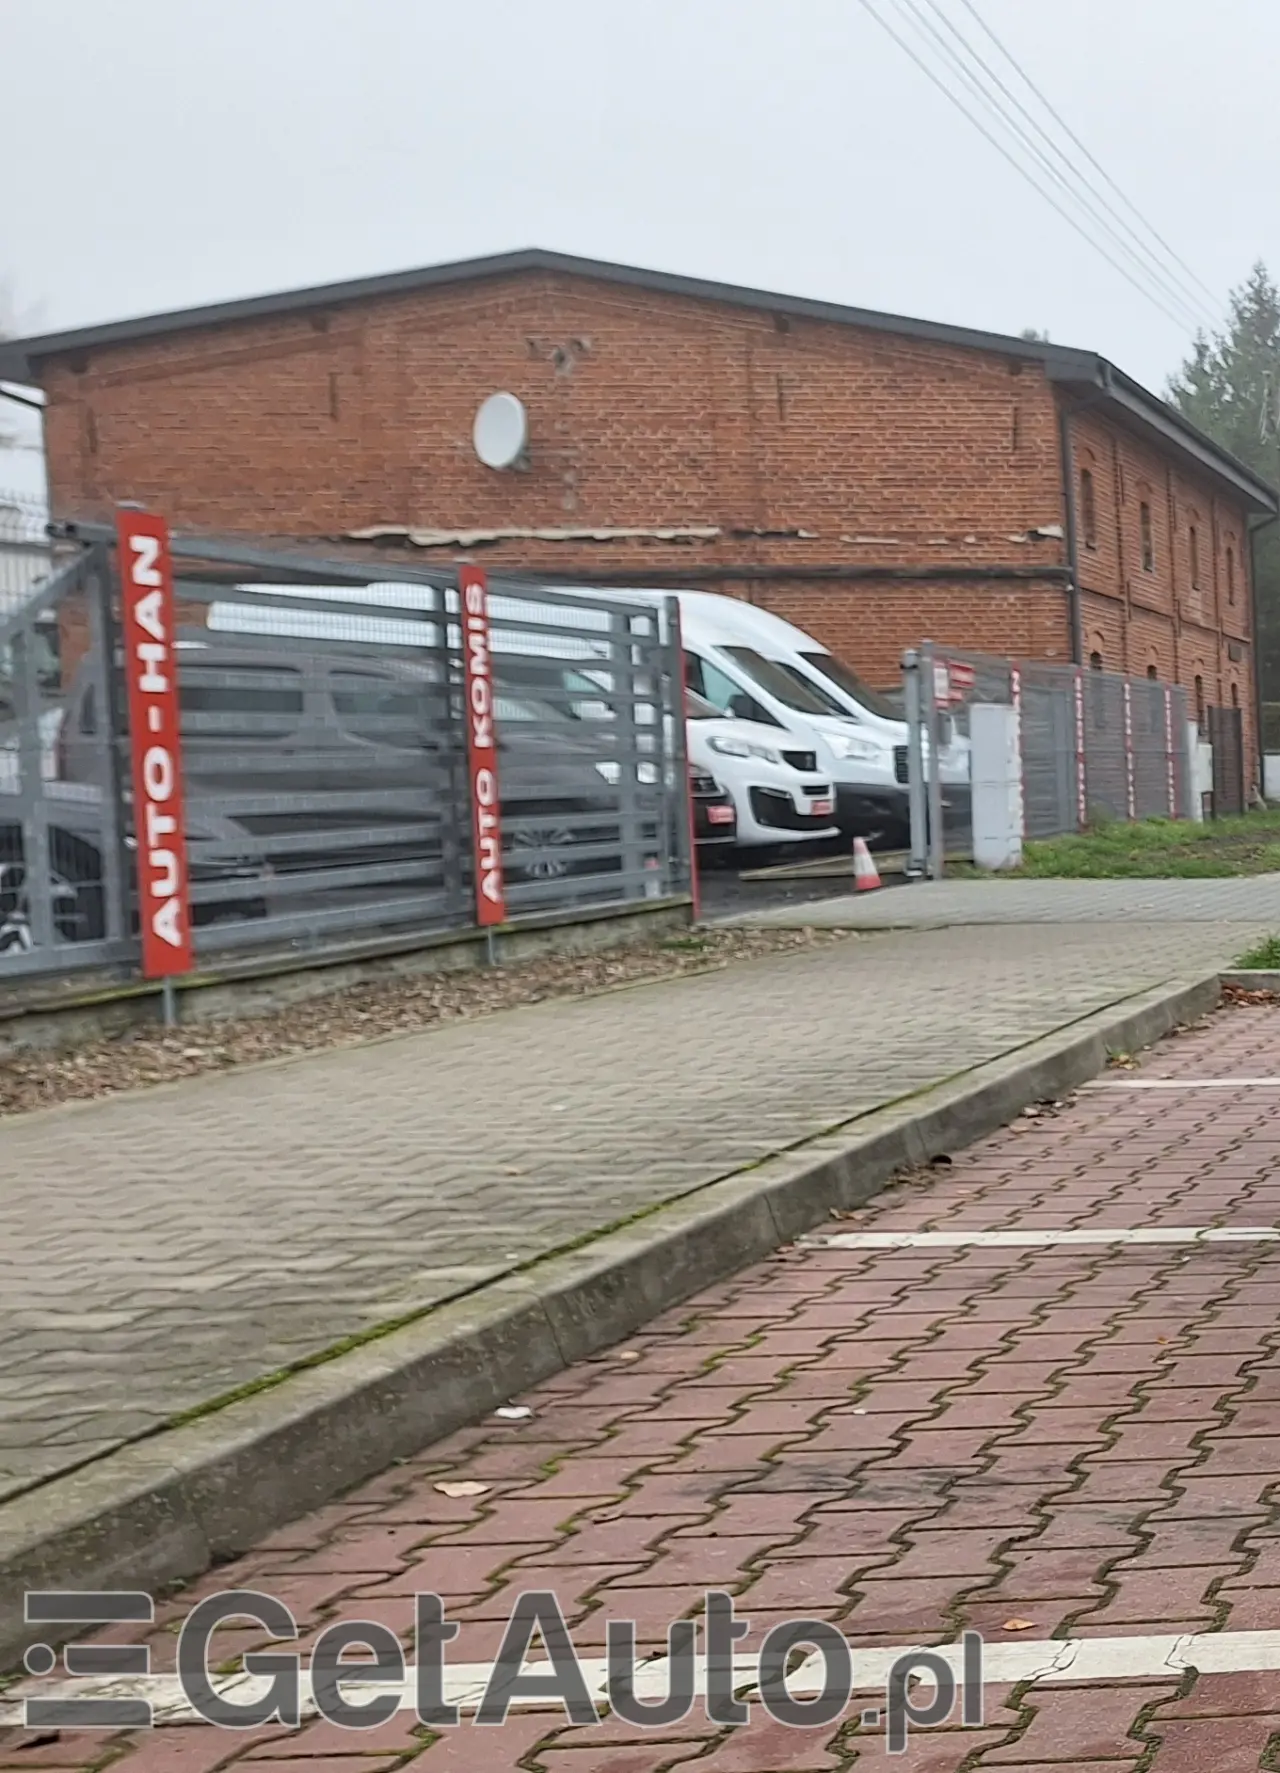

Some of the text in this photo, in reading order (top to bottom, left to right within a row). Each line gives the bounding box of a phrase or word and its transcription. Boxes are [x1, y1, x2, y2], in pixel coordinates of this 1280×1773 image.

[129, 534, 169, 693] HAN
[464, 582, 500, 904] AUTO KOMIS
[143, 745, 183, 948] AUTO
